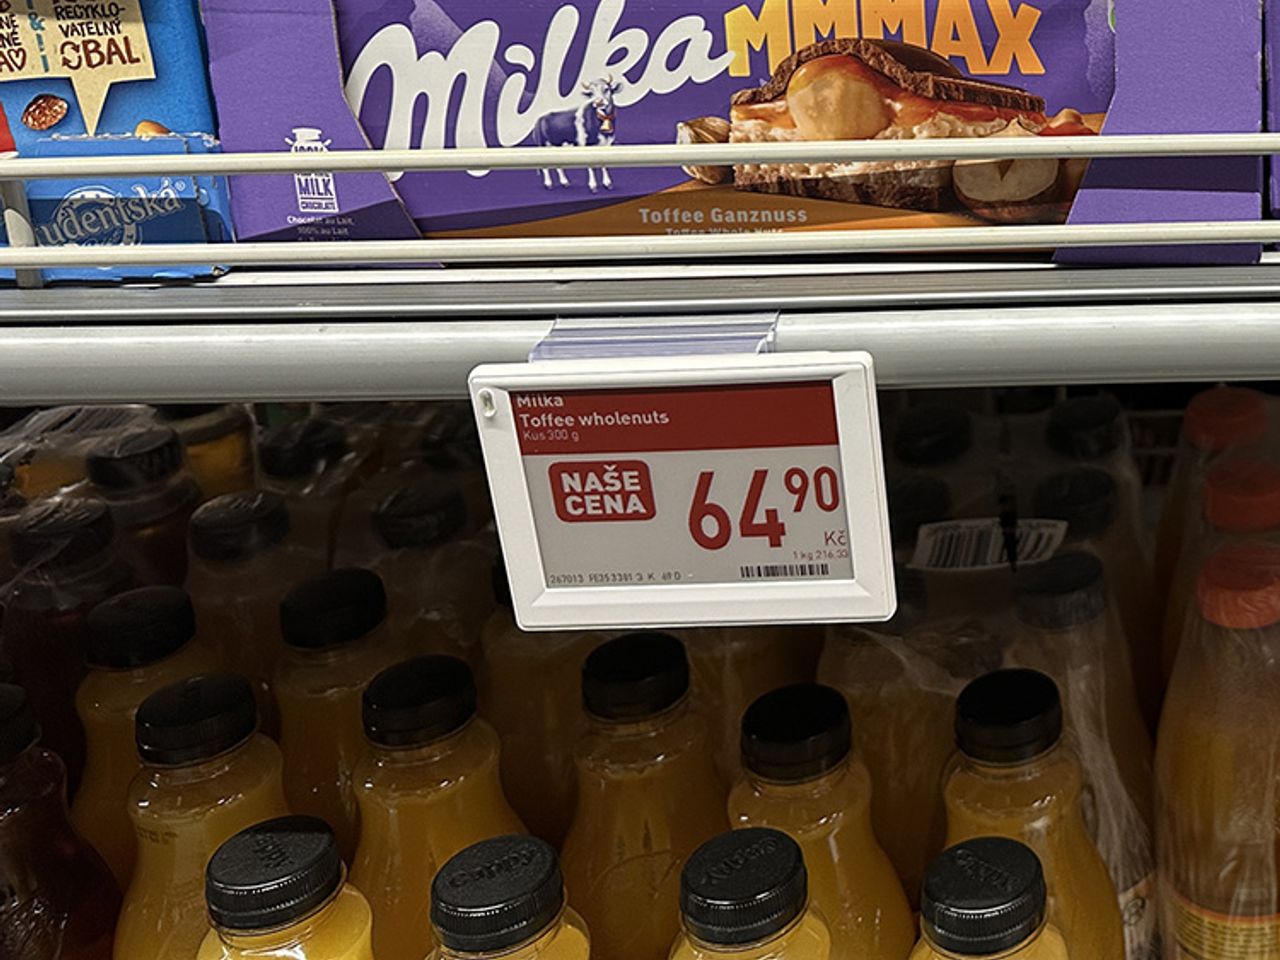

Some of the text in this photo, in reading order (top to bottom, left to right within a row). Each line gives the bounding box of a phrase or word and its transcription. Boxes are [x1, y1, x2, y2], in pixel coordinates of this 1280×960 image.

[54, 1, 126, 21] RECYKLO-
[58, 18, 122, 38] VATELNÝ
[296, 177, 334, 197] MILK
[638, 207, 808, 224] Toffee Ganznuss
[516, 393, 564, 408] Milka
[519, 410, 670, 428] Toffee wholenuts
[523, 428, 580, 442] Kus 300 g
[560, 464, 642, 494] NAŠE
[565, 493, 647, 516] CENA
[823, 529, 847, 546] Kč
